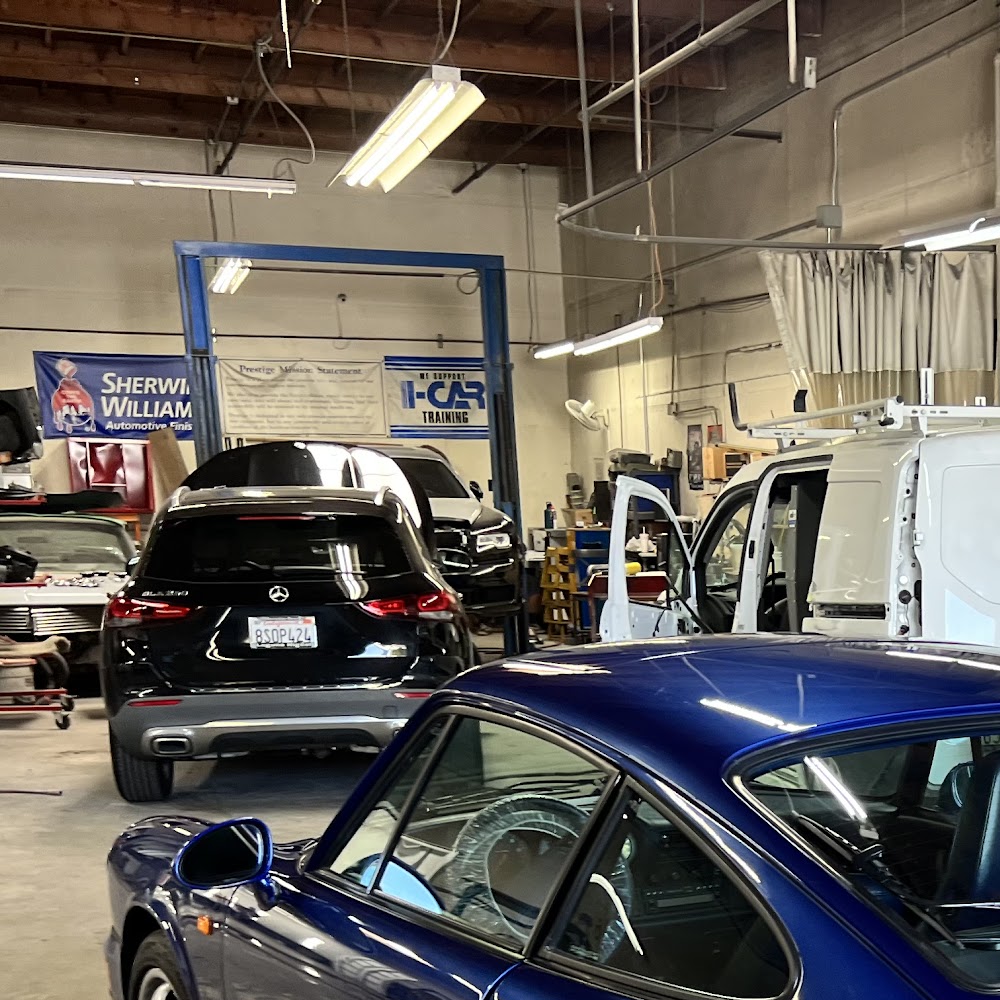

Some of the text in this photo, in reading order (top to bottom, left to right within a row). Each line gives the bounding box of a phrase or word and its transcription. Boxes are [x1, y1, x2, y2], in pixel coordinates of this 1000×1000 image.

[401, 380, 486, 410] I-CAR
[422, 411, 469, 424] TRAINING
[105, 421, 167, 431] Automotive
